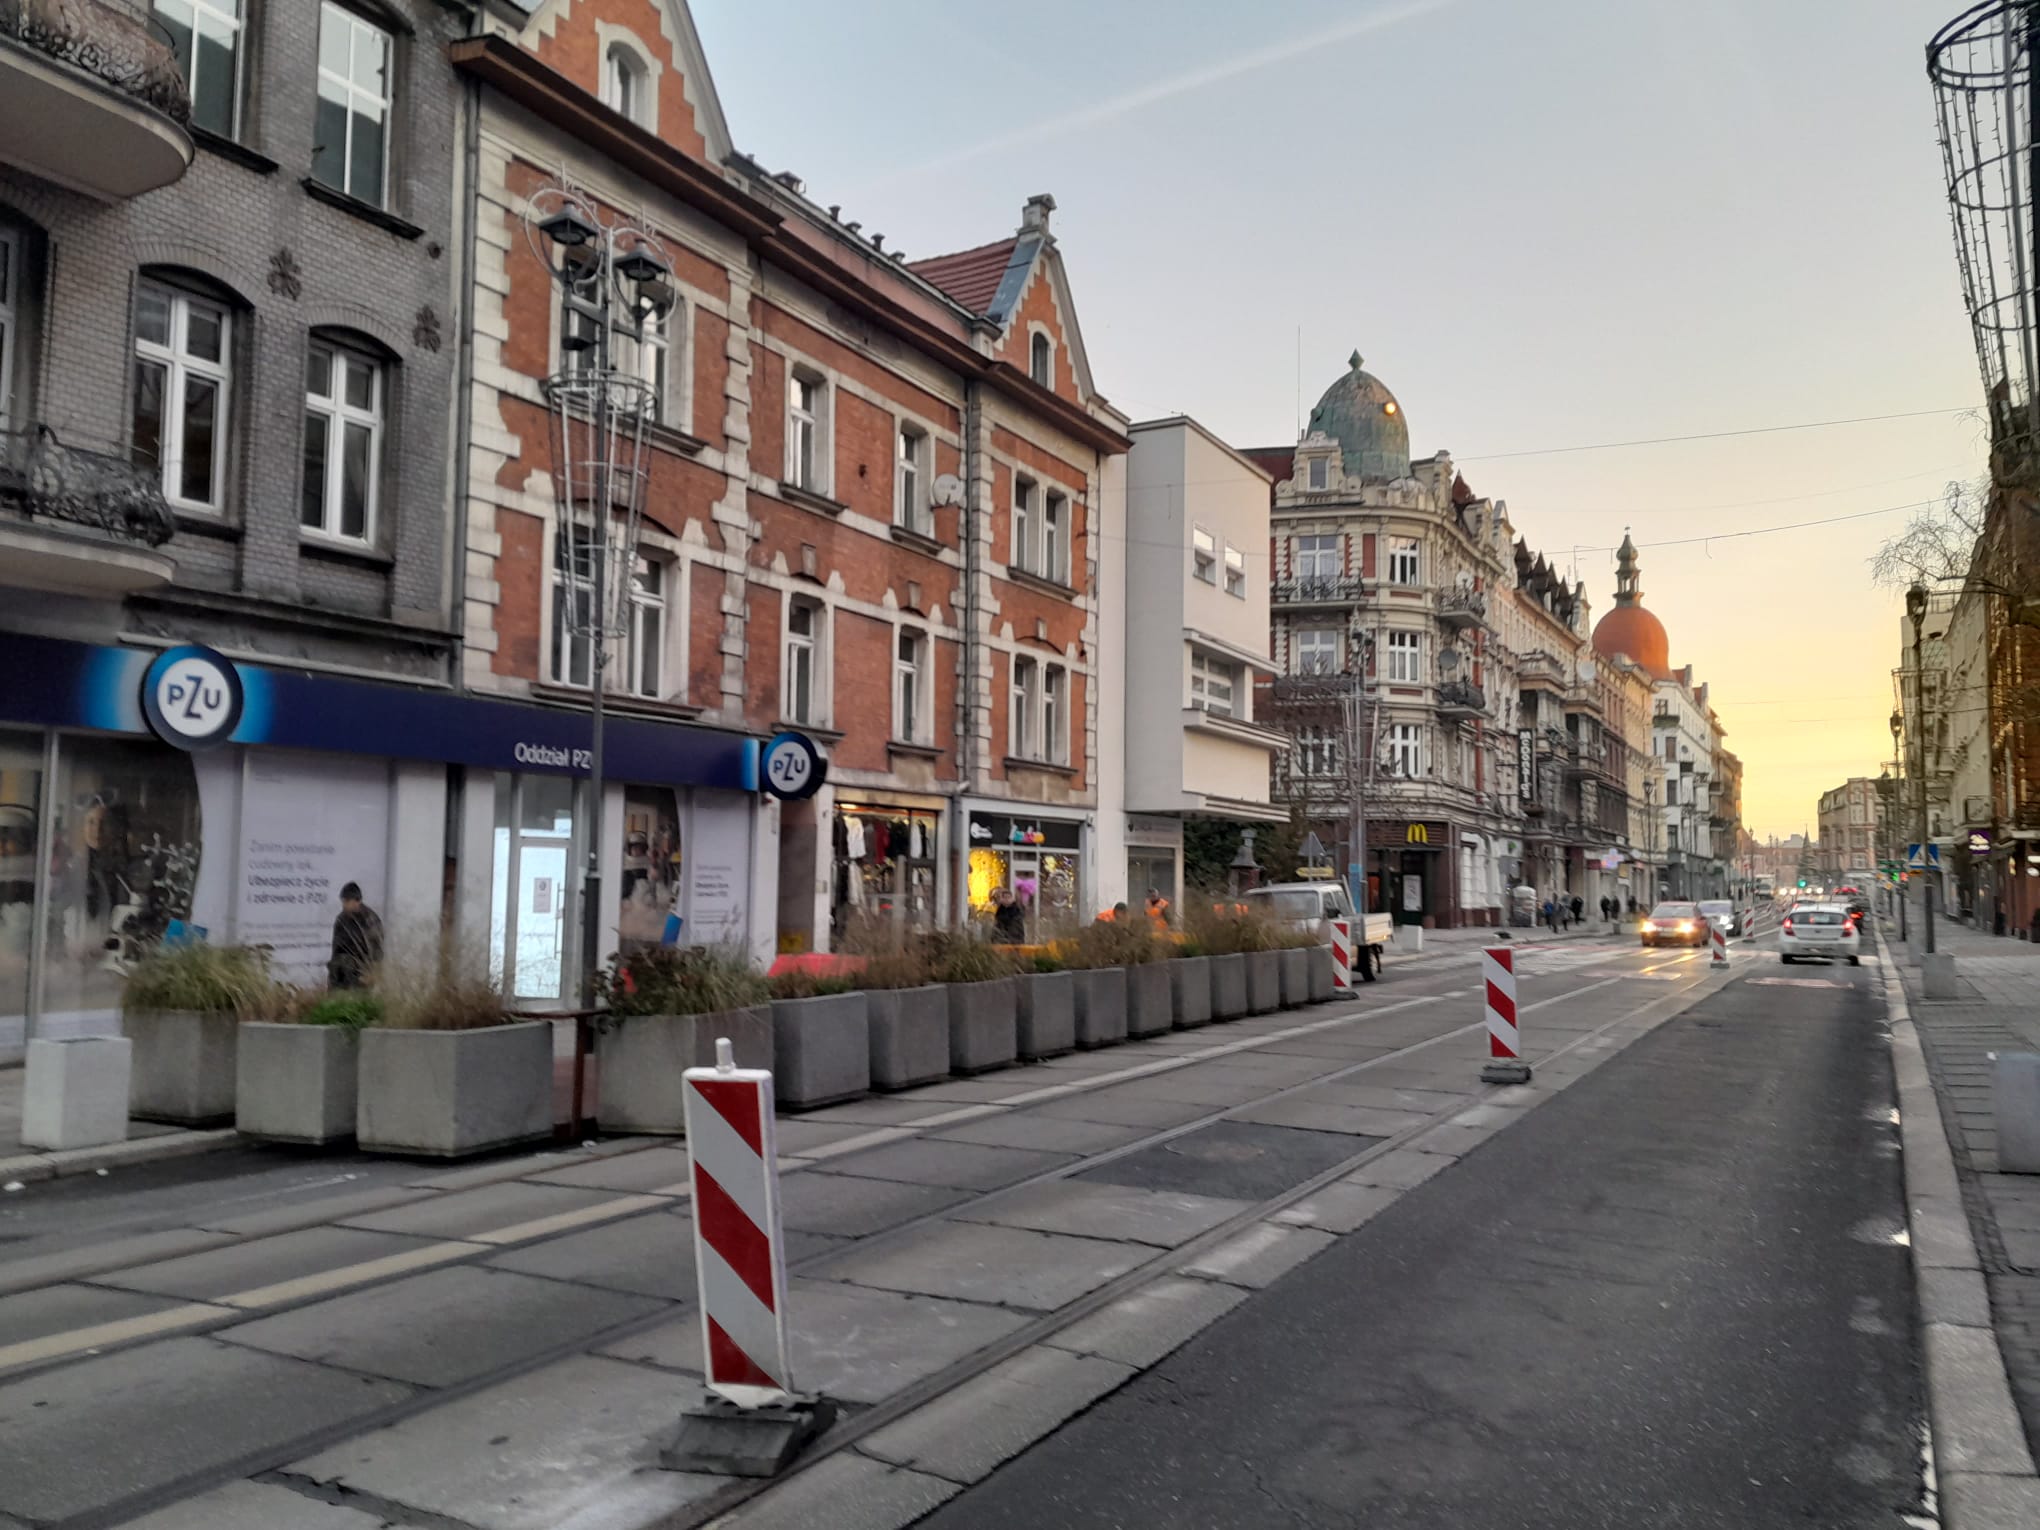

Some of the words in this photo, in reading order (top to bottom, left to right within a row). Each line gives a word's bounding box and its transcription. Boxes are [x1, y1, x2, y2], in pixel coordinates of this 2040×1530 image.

[168, 674, 222, 719] PZU
[572, 748, 593, 769] PZ
[773, 752, 805, 781] PZU
